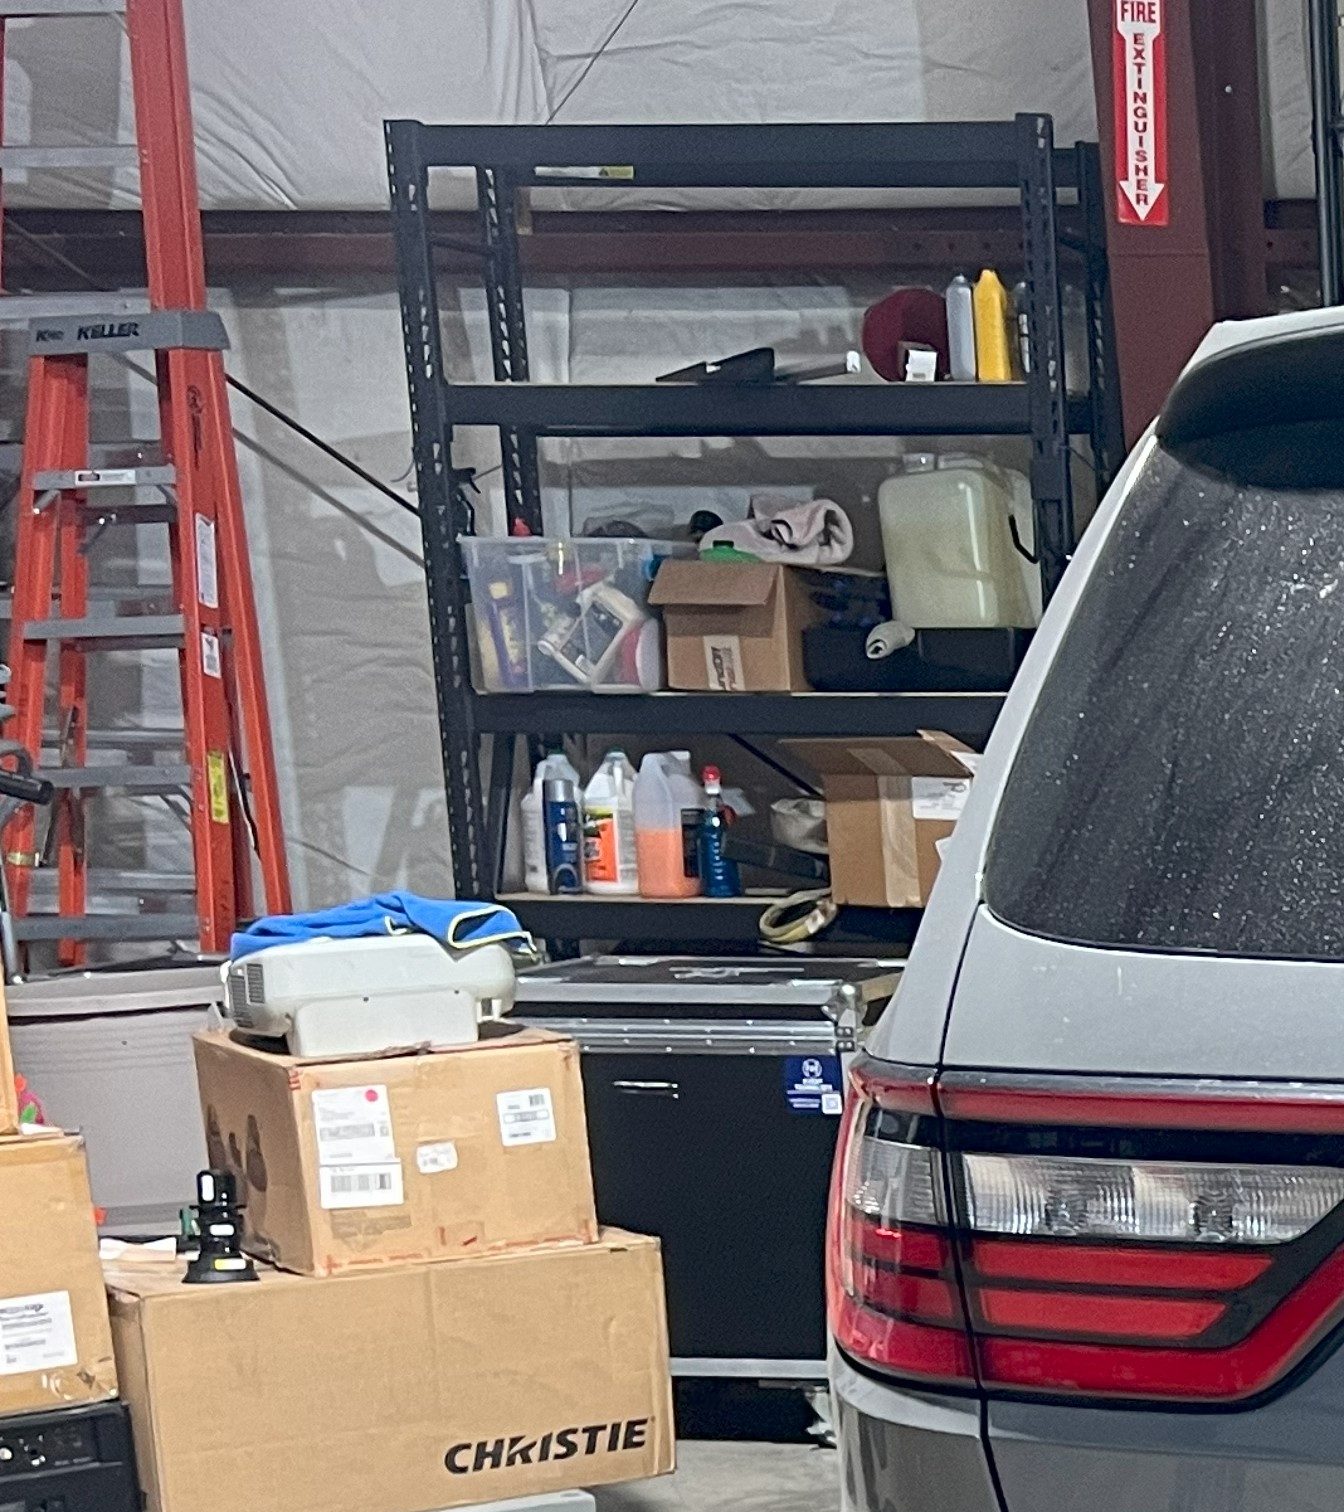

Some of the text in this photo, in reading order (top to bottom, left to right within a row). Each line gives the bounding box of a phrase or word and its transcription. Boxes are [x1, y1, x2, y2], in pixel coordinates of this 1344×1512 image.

[1120, 1, 1157, 23] FIRE
[1133, 32, 1149, 206] EXTINGUISHER
[77, 322, 139, 340] KELLER
[444, 1417, 649, 1475] CHRISTIE
